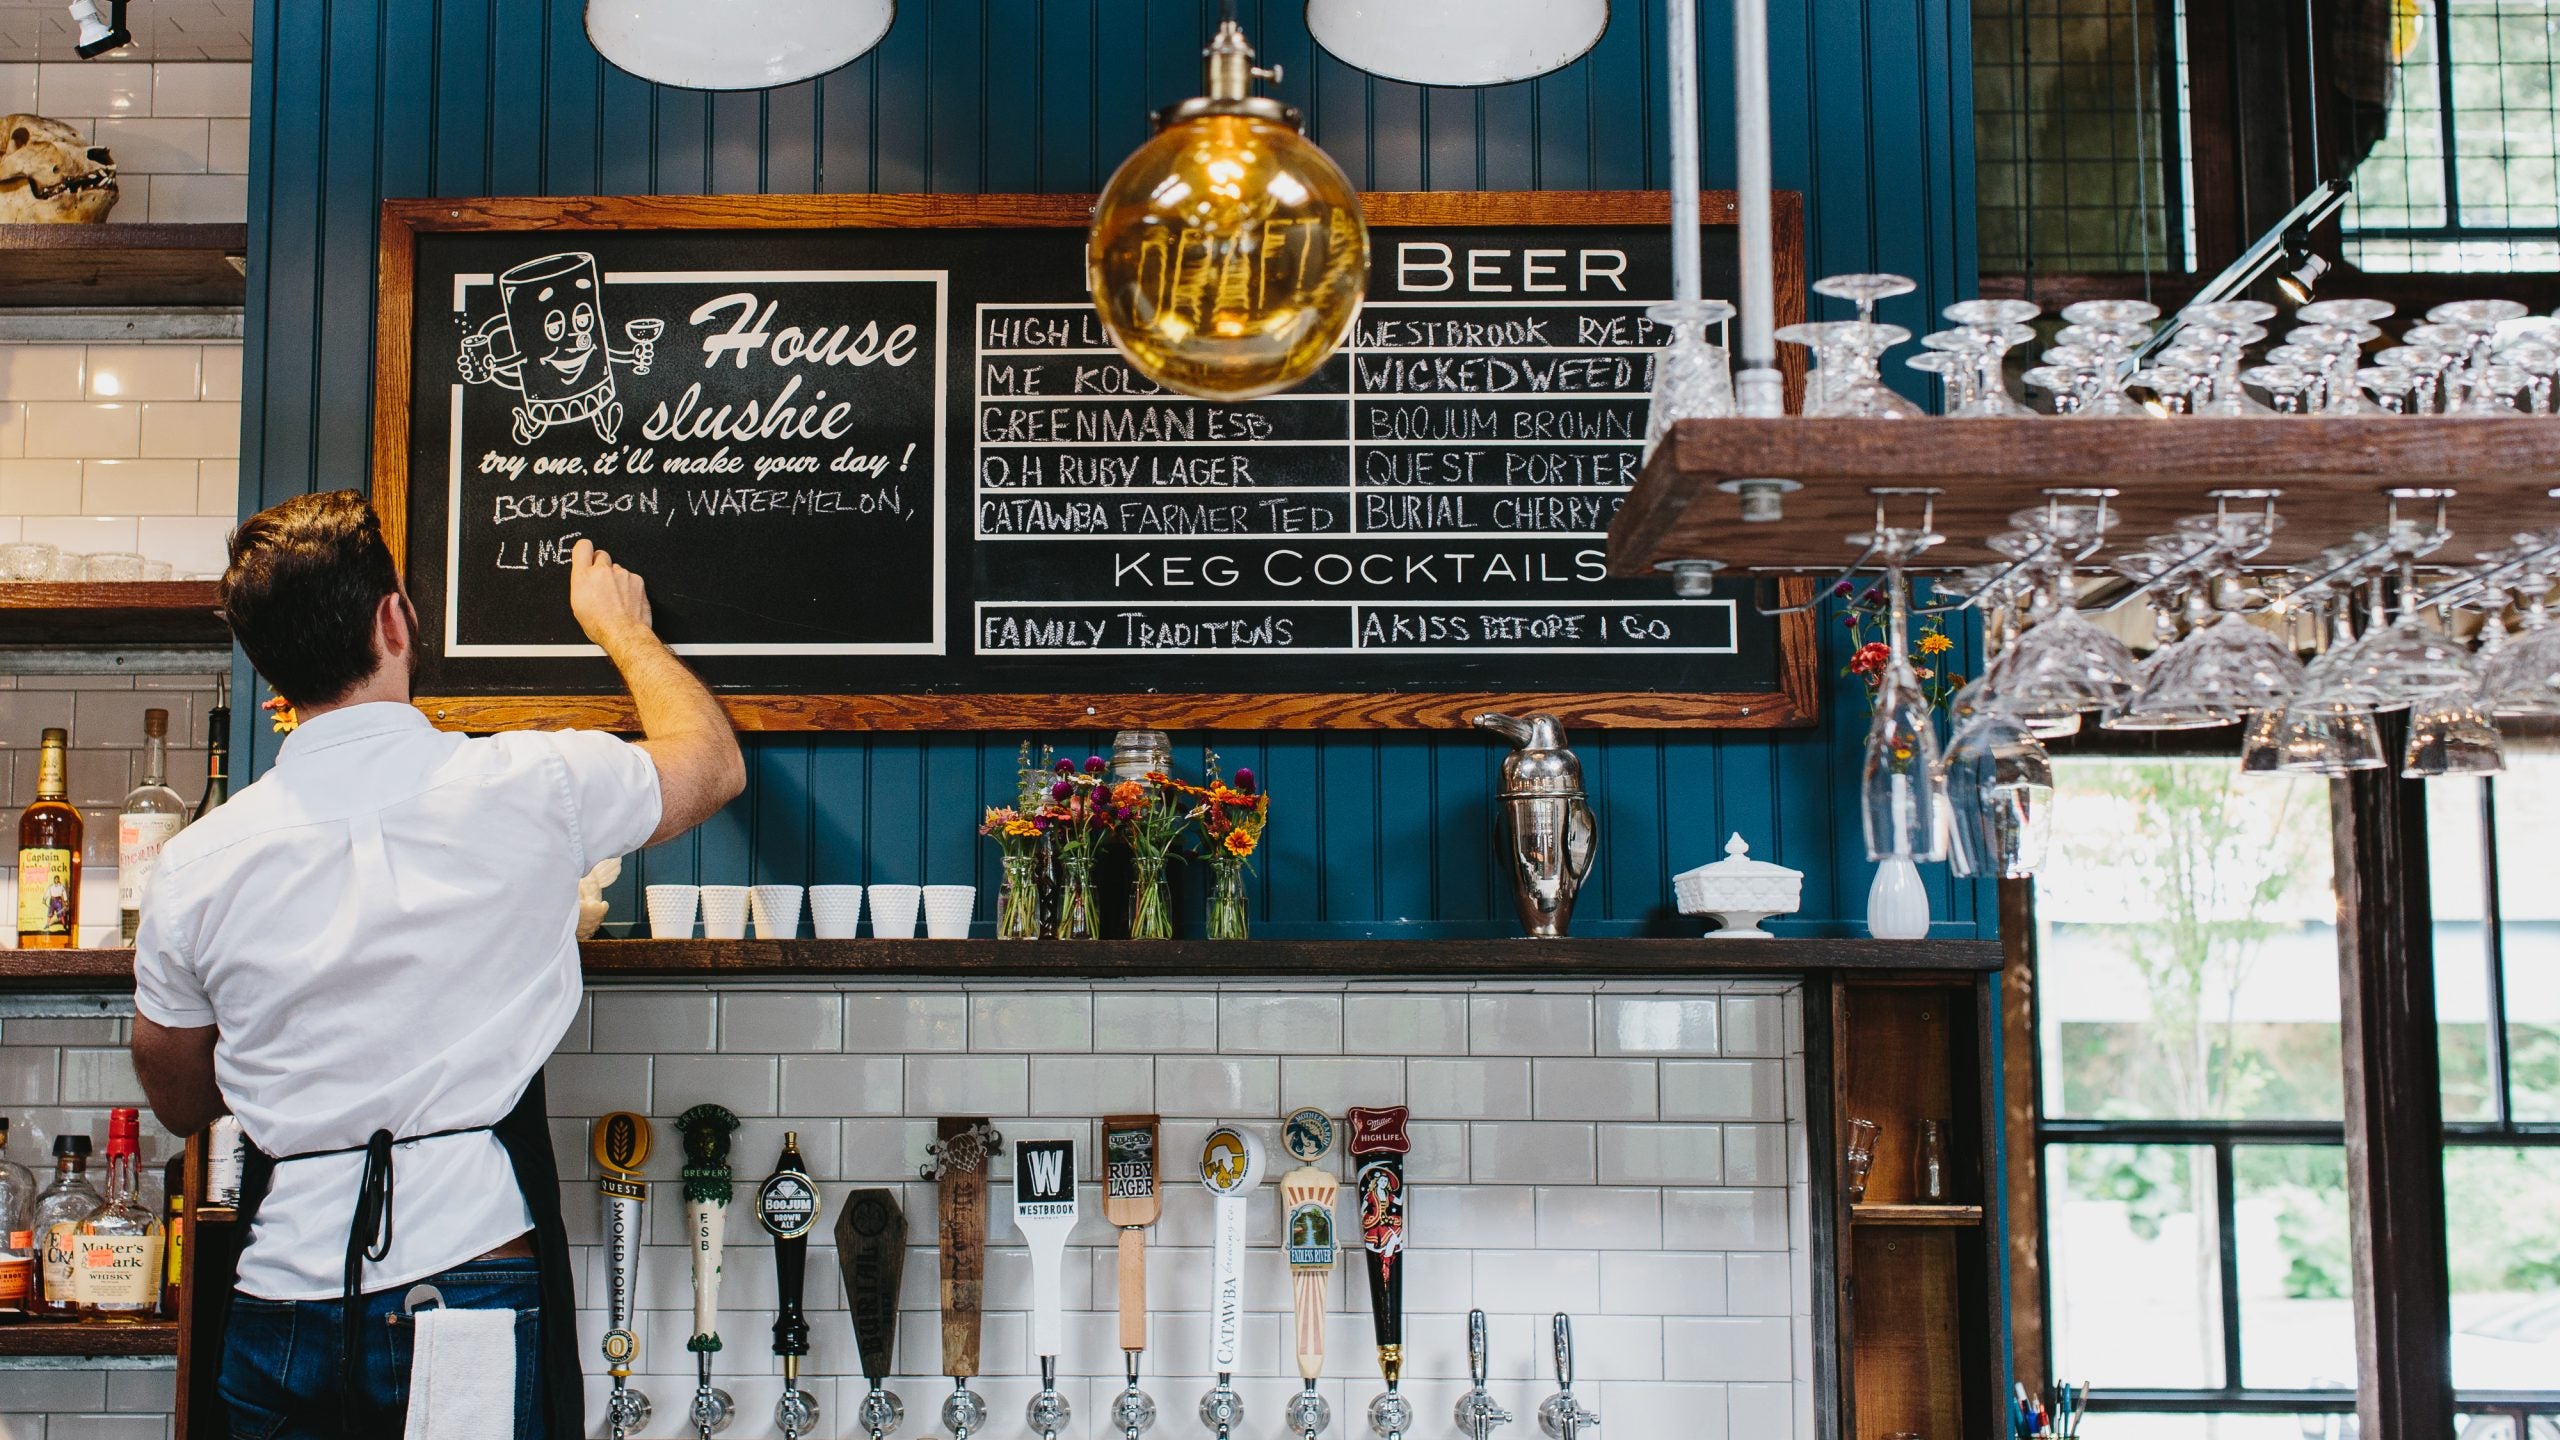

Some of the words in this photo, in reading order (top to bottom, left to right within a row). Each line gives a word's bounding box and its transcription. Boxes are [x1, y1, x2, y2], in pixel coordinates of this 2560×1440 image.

[1398, 243, 1626, 292] BEER
[689, 293, 917, 369] House
[989, 318, 1069, 347] HIGH
[1356, 317, 1548, 347] WESTBROOK
[1075, 365, 1160, 395] KOLS
[641, 374, 854, 442] slushie
[1372, 406, 1496, 439] BOOJUM
[1514, 410, 1632, 438] BROWN
[1208, 409, 1272, 439] ESB
[478, 450, 528, 481] try
[663, 446, 744, 474] make
[754, 456, 820, 481] your
[830, 447, 890, 478] day
[1060, 455, 1139, 486] RUBY
[1152, 456, 1255, 486] LAGER
[1366, 451, 1485, 485] QUEST
[1506, 453, 1637, 485] PORTER
[981, 499, 1108, 533] CATAWBA
[1120, 503, 1248, 533] FARMER
[1259, 497, 1334, 533] TED
[1366, 494, 1478, 530] BURIAL
[1493, 494, 1601, 531] CHERRY
[496, 533, 582, 568] LIME
[1116, 553, 1239, 586] KEG
[1264, 550, 1607, 586] COCKTAILS
[985, 617, 1105, 648] FAMILY
[1620, 616, 1670, 640] GO
[26, 852, 60, 862] Captain
[1295, 1112, 1324, 1122] MOTHER
[1366, 1117, 1393, 1131] Miller
[1361, 1134, 1381, 1142] HIGH
[683, 1169, 729, 1177] BREWERY
[1109, 1163, 1153, 1179] RUBY
[602, 1179, 638, 1195] QUEST
[1108, 1179, 1154, 1196] LAGER
[765, 1199, 811, 1210] BOOJUM
[774, 1213, 801, 1221] BROWN
[1019, 1204, 1075, 1216] WESTBROOK
[613, 1201, 625, 1263] SMOKED
[780, 1221, 795, 1229] ALE
[112, 1256, 144, 1268] ark
[1291, 1249, 1314, 1263] ENDLESS
[1314, 1249, 1332, 1263] RIVER
[613, 1266, 625, 1323] PORTER
[1216, 1277, 1236, 1365] CATAWBA
